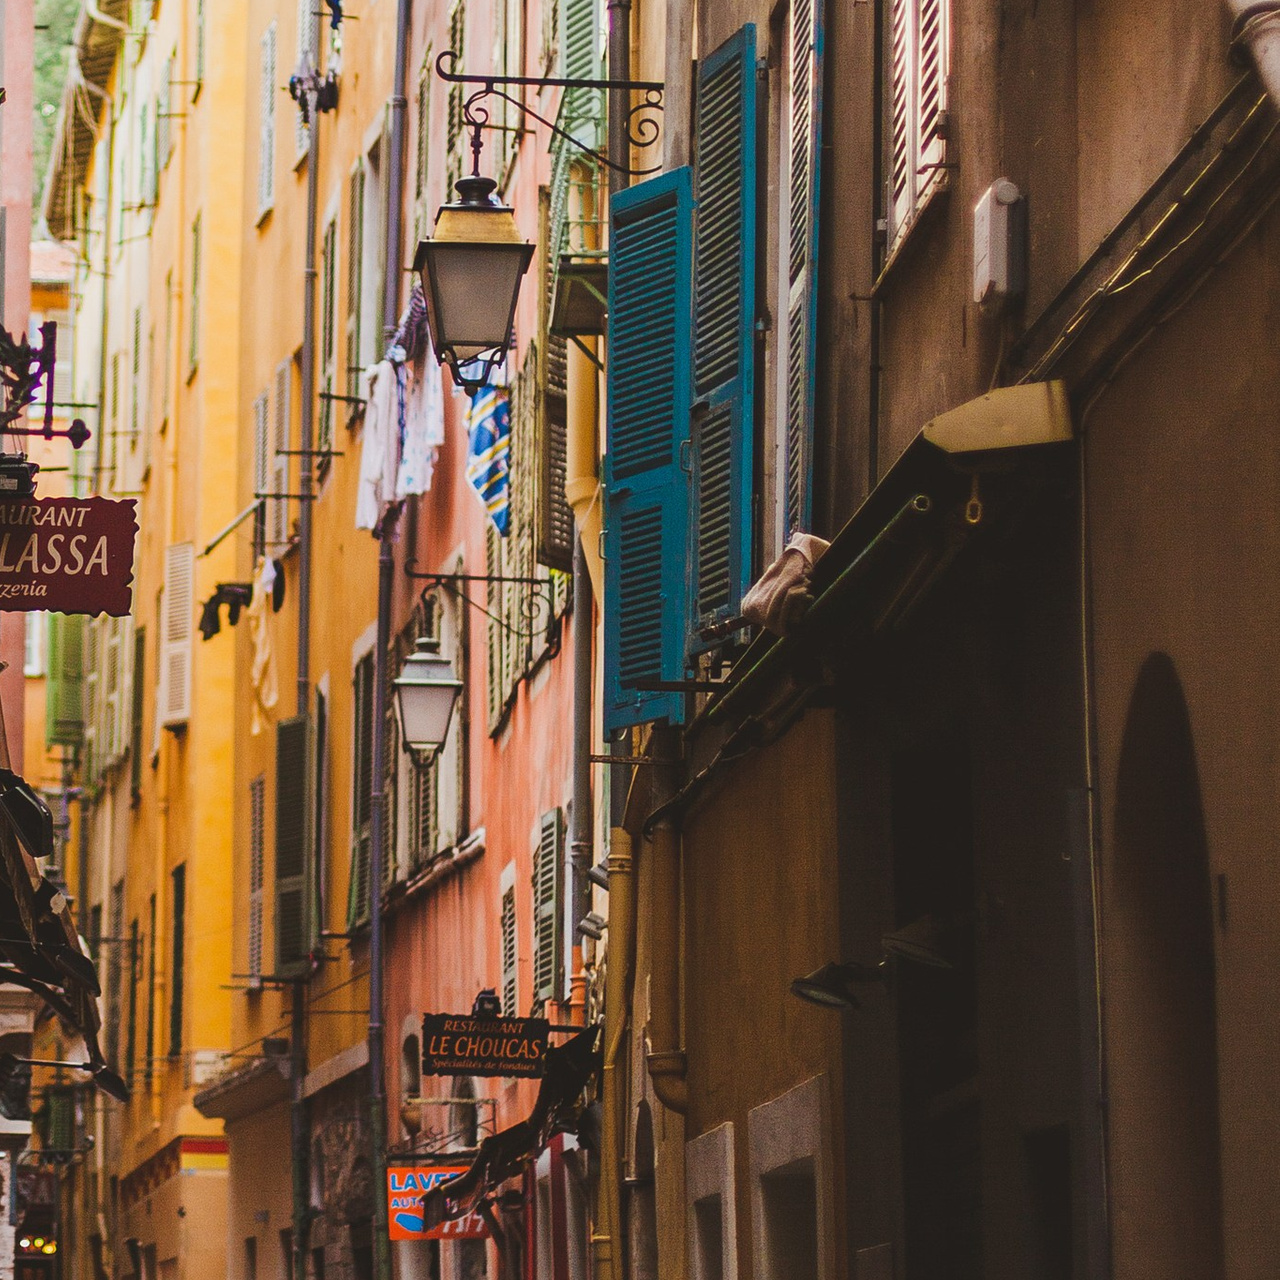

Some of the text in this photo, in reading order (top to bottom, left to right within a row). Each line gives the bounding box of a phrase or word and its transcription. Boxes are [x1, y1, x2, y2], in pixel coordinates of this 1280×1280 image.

[443, 1019, 526, 1034] RESTAURANT
[429, 1035, 541, 1059] LE CHOUCAS
